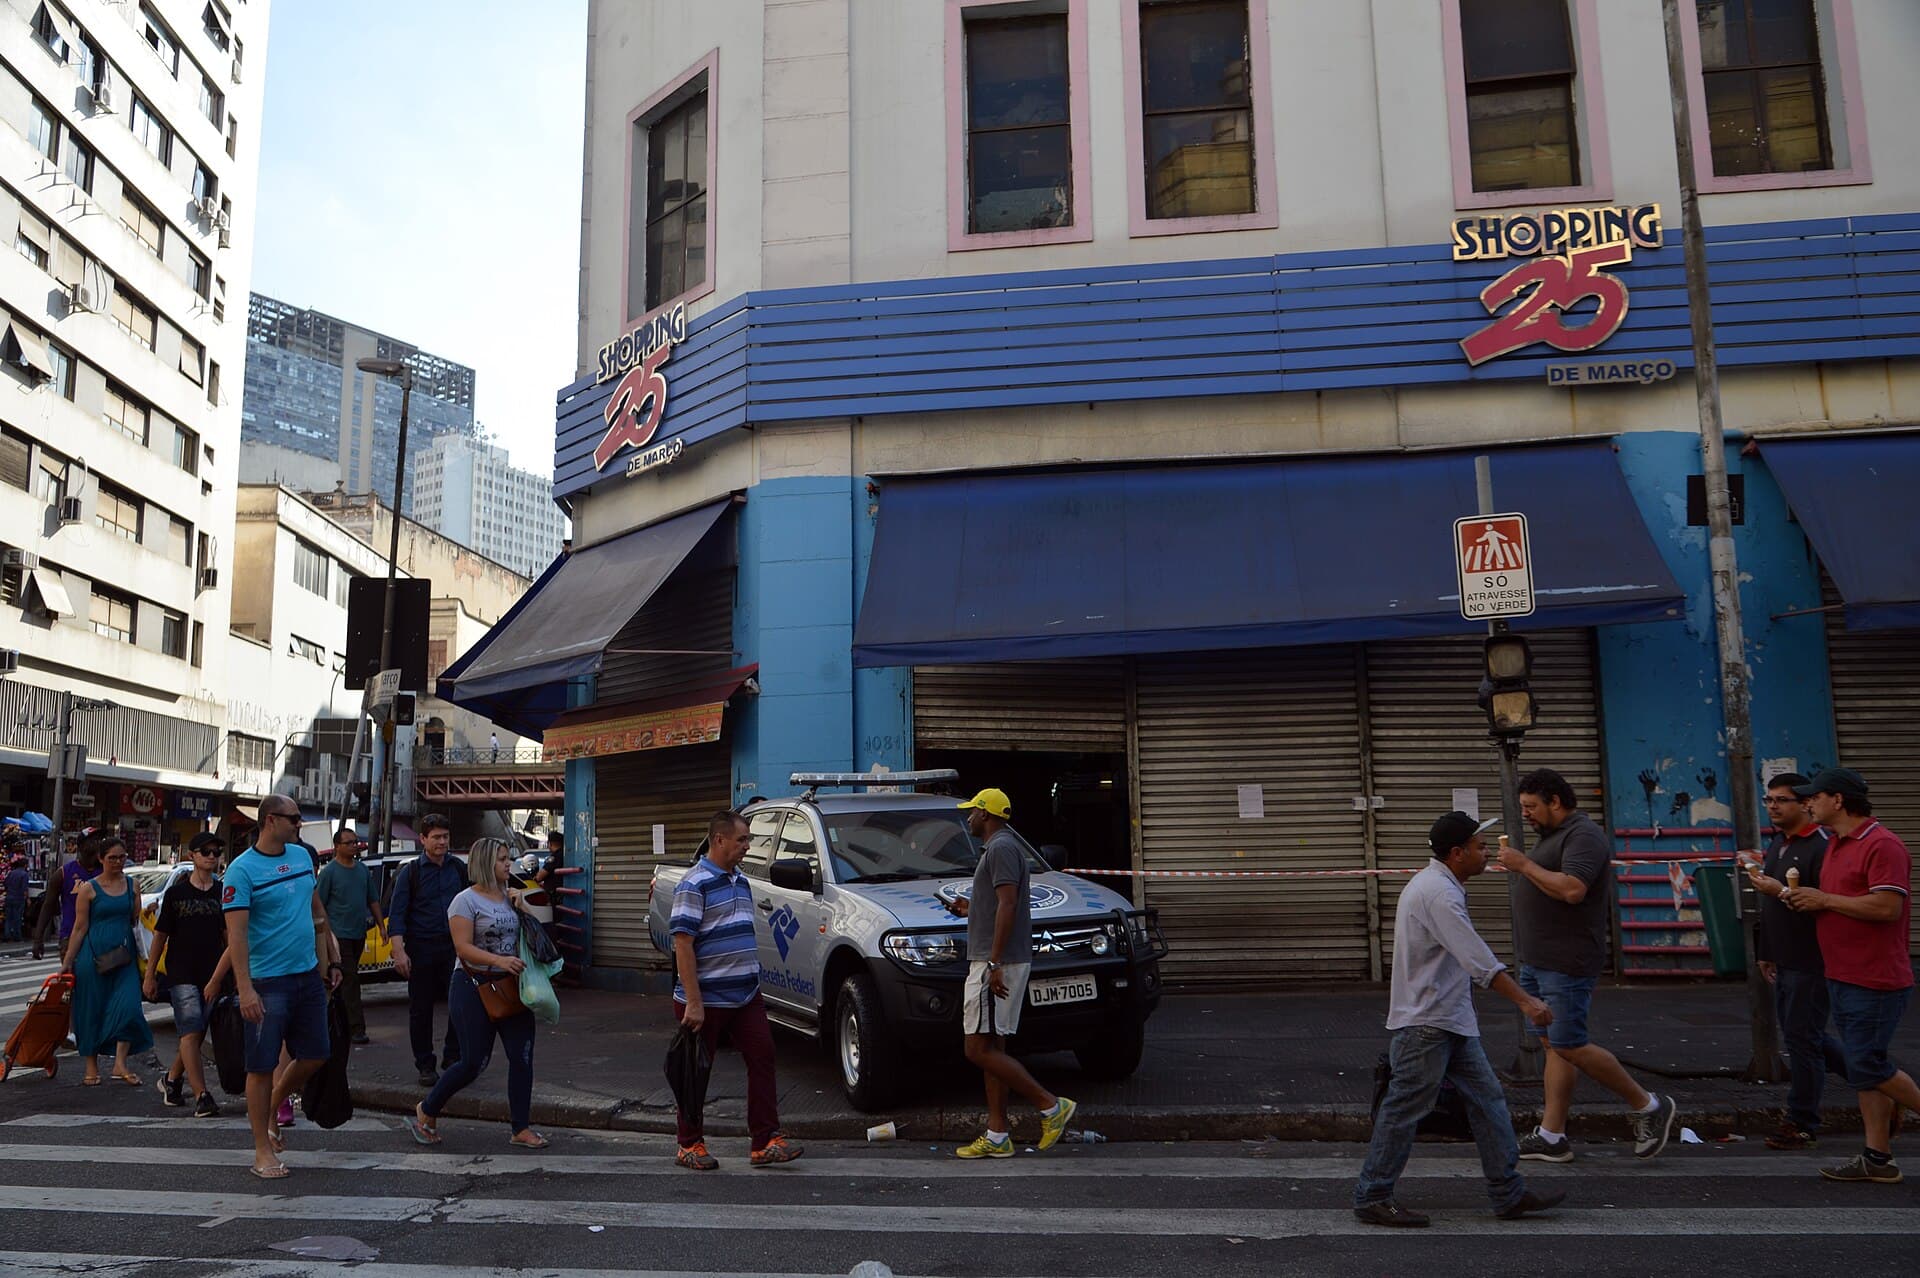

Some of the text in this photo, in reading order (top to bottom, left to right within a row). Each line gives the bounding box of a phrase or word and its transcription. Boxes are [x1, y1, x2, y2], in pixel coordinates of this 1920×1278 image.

[1454, 205, 1660, 257] SHOPPING
[1459, 238, 1631, 365] 25
[597, 303, 685, 383] SHOPPING
[1550, 361, 1672, 383] DE MARÇO
[594, 344, 667, 471] 25
[627, 440, 682, 474] DE MARÇO
[1467, 589, 1528, 602] ATRAVESSE
[1469, 600, 1528, 613] NO VERDE
[223, 886, 236, 904] 2
[786, 969, 817, 998] Federal
